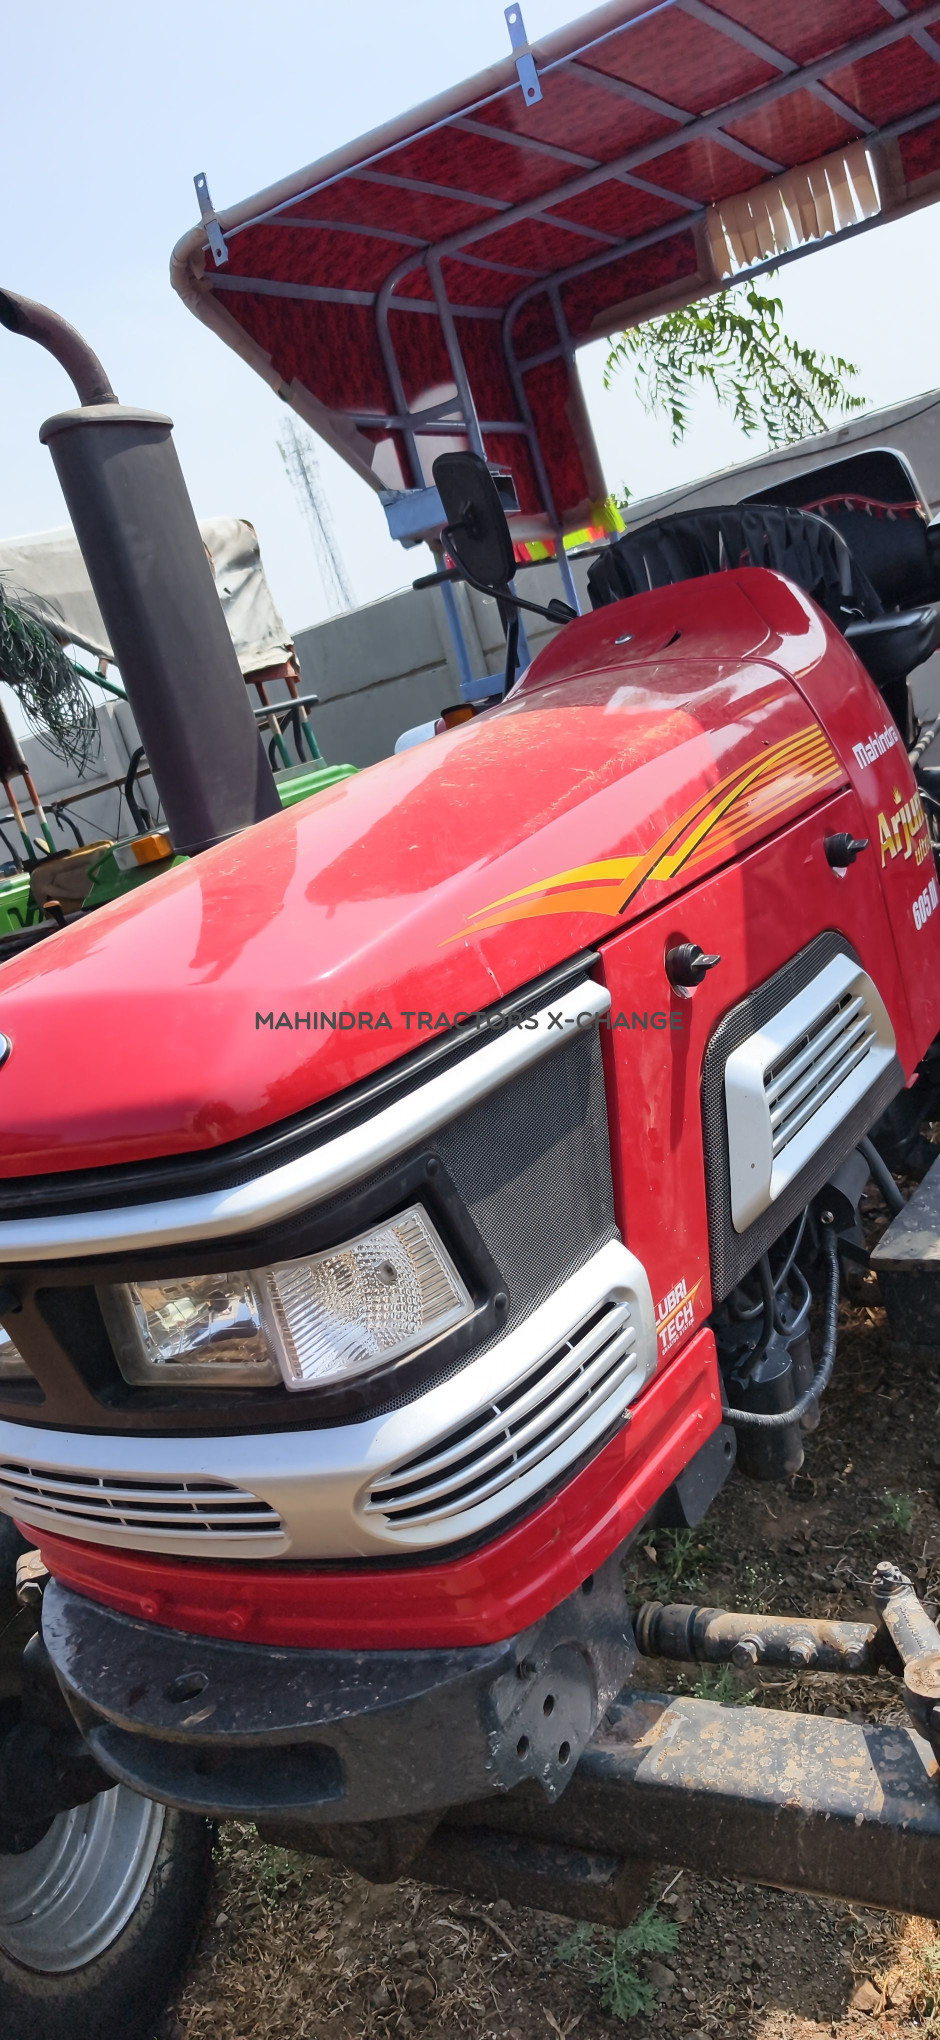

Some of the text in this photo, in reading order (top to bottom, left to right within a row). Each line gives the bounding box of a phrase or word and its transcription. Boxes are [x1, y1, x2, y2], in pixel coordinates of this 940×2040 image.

[851, 724, 899, 770] Mahindra
[912, 887, 932, 931] 605
[659, 1300, 695, 1348] TECH
